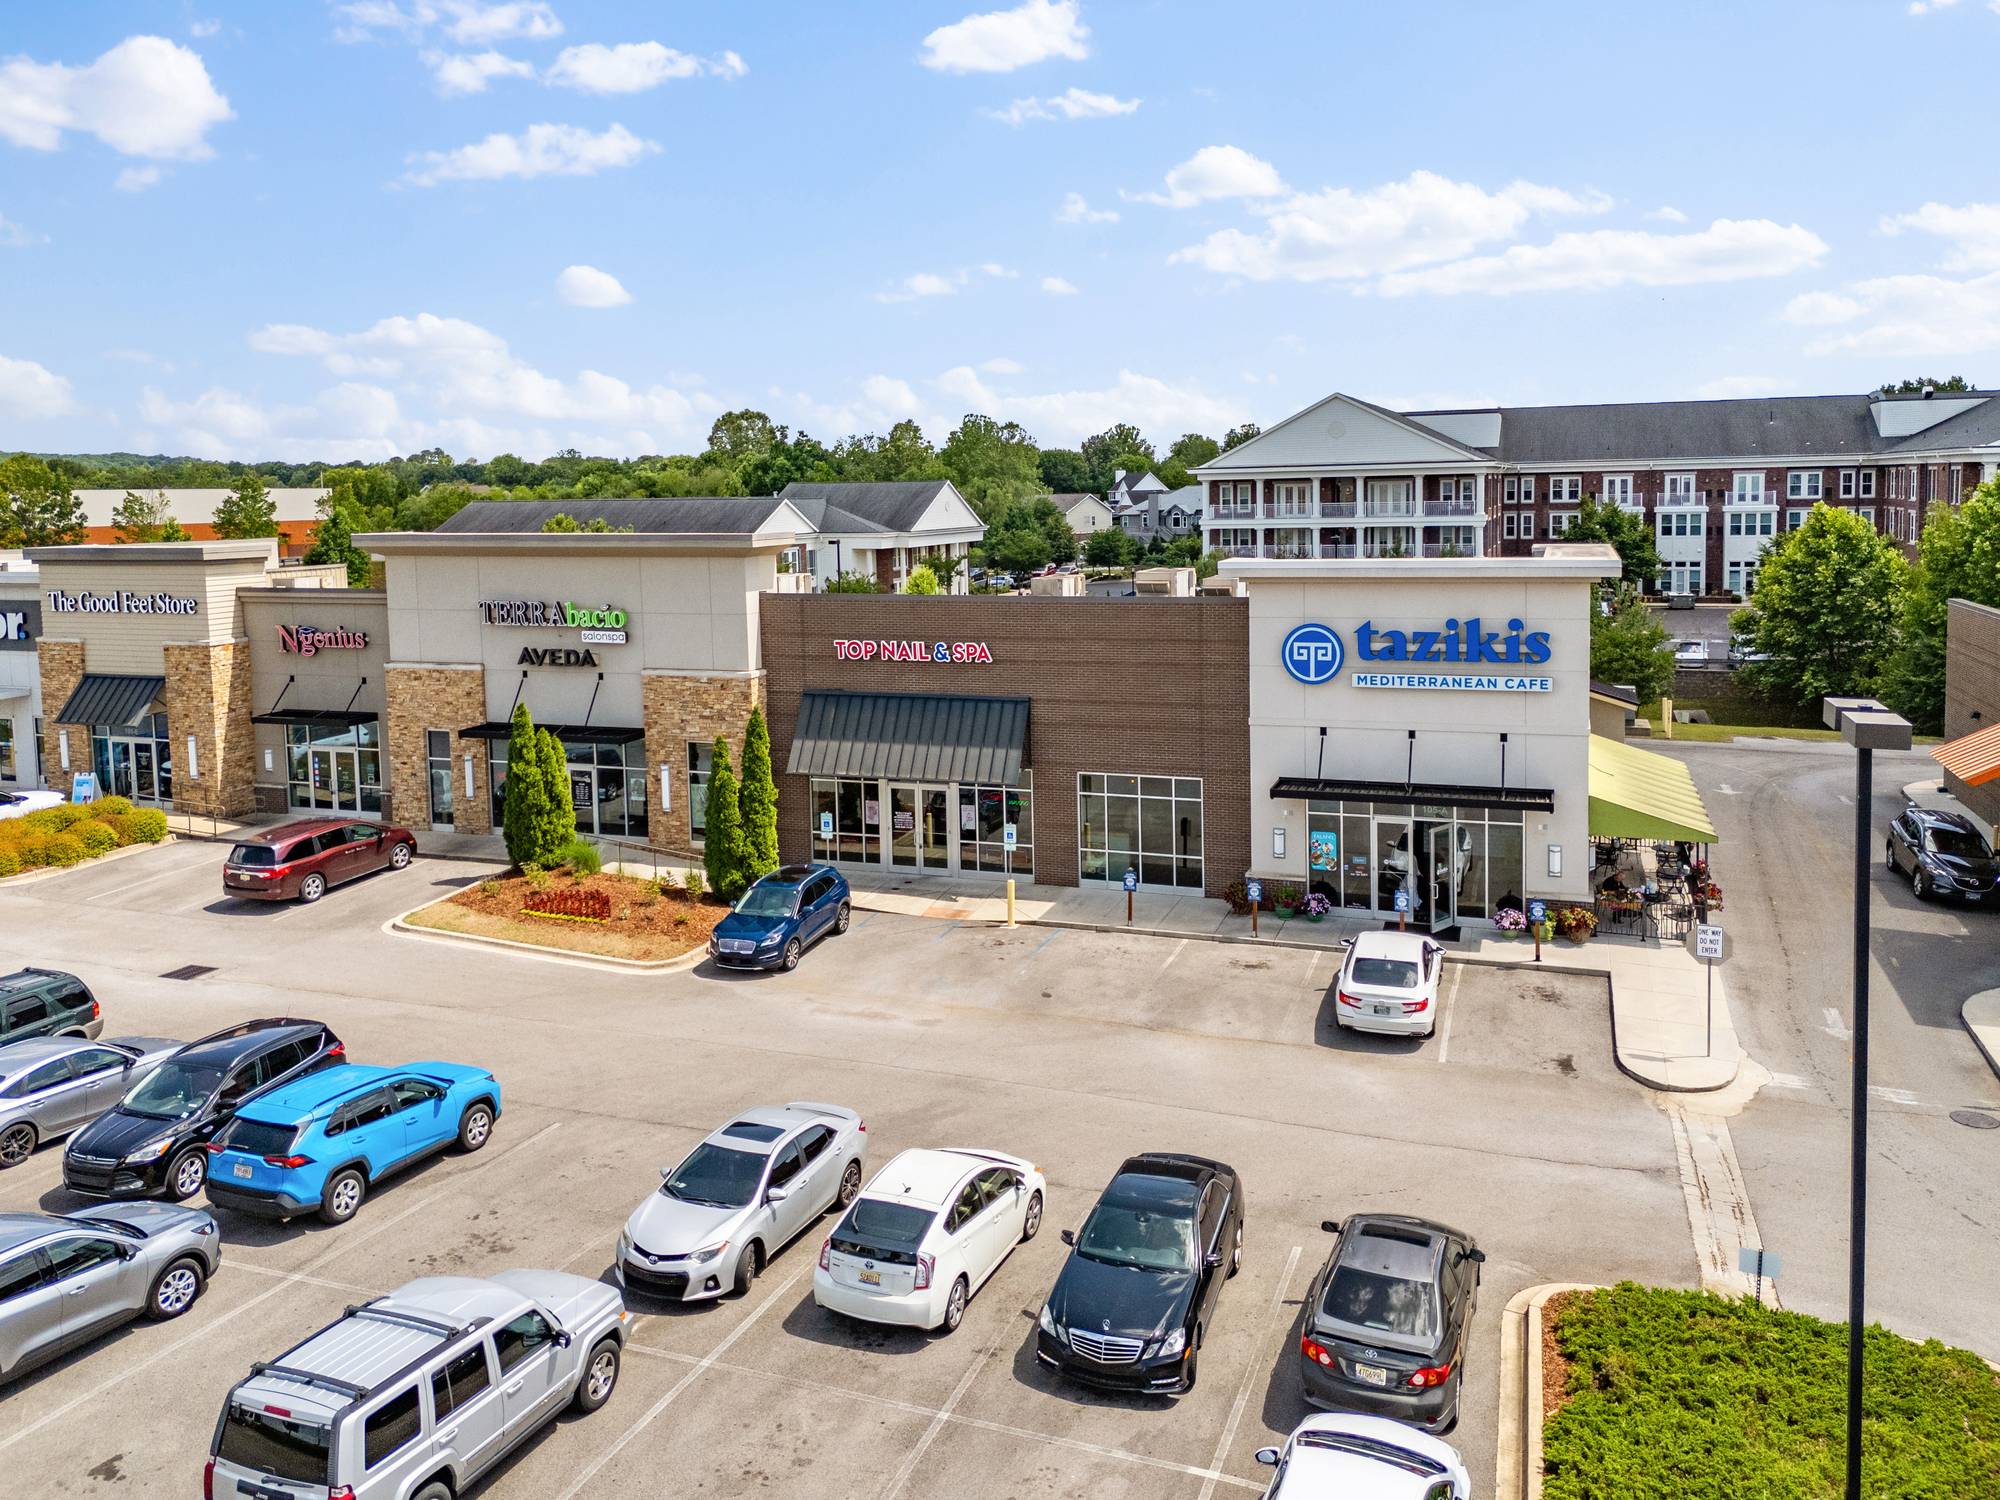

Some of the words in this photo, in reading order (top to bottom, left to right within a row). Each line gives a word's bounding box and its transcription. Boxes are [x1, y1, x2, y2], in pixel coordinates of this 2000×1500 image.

[47, 591, 77, 612] The
[79, 591, 120, 613] Good
[122, 592, 154, 613] Feet
[156, 593, 198, 614] Store
[274, 623, 369, 657] Ngenius
[582, 632, 625, 643] salonspa
[1353, 617, 1552, 664] tazikis
[517, 647, 598, 667] AVEDA
[834, 640, 877, 660] TOP
[881, 641, 931, 661] NAIL
[933, 642, 950, 662] &
[952, 642, 993, 663] SPA
[1357, 675, 1498, 690] MEDITERRANEAN
[1504, 678, 1550, 691] CAFE
